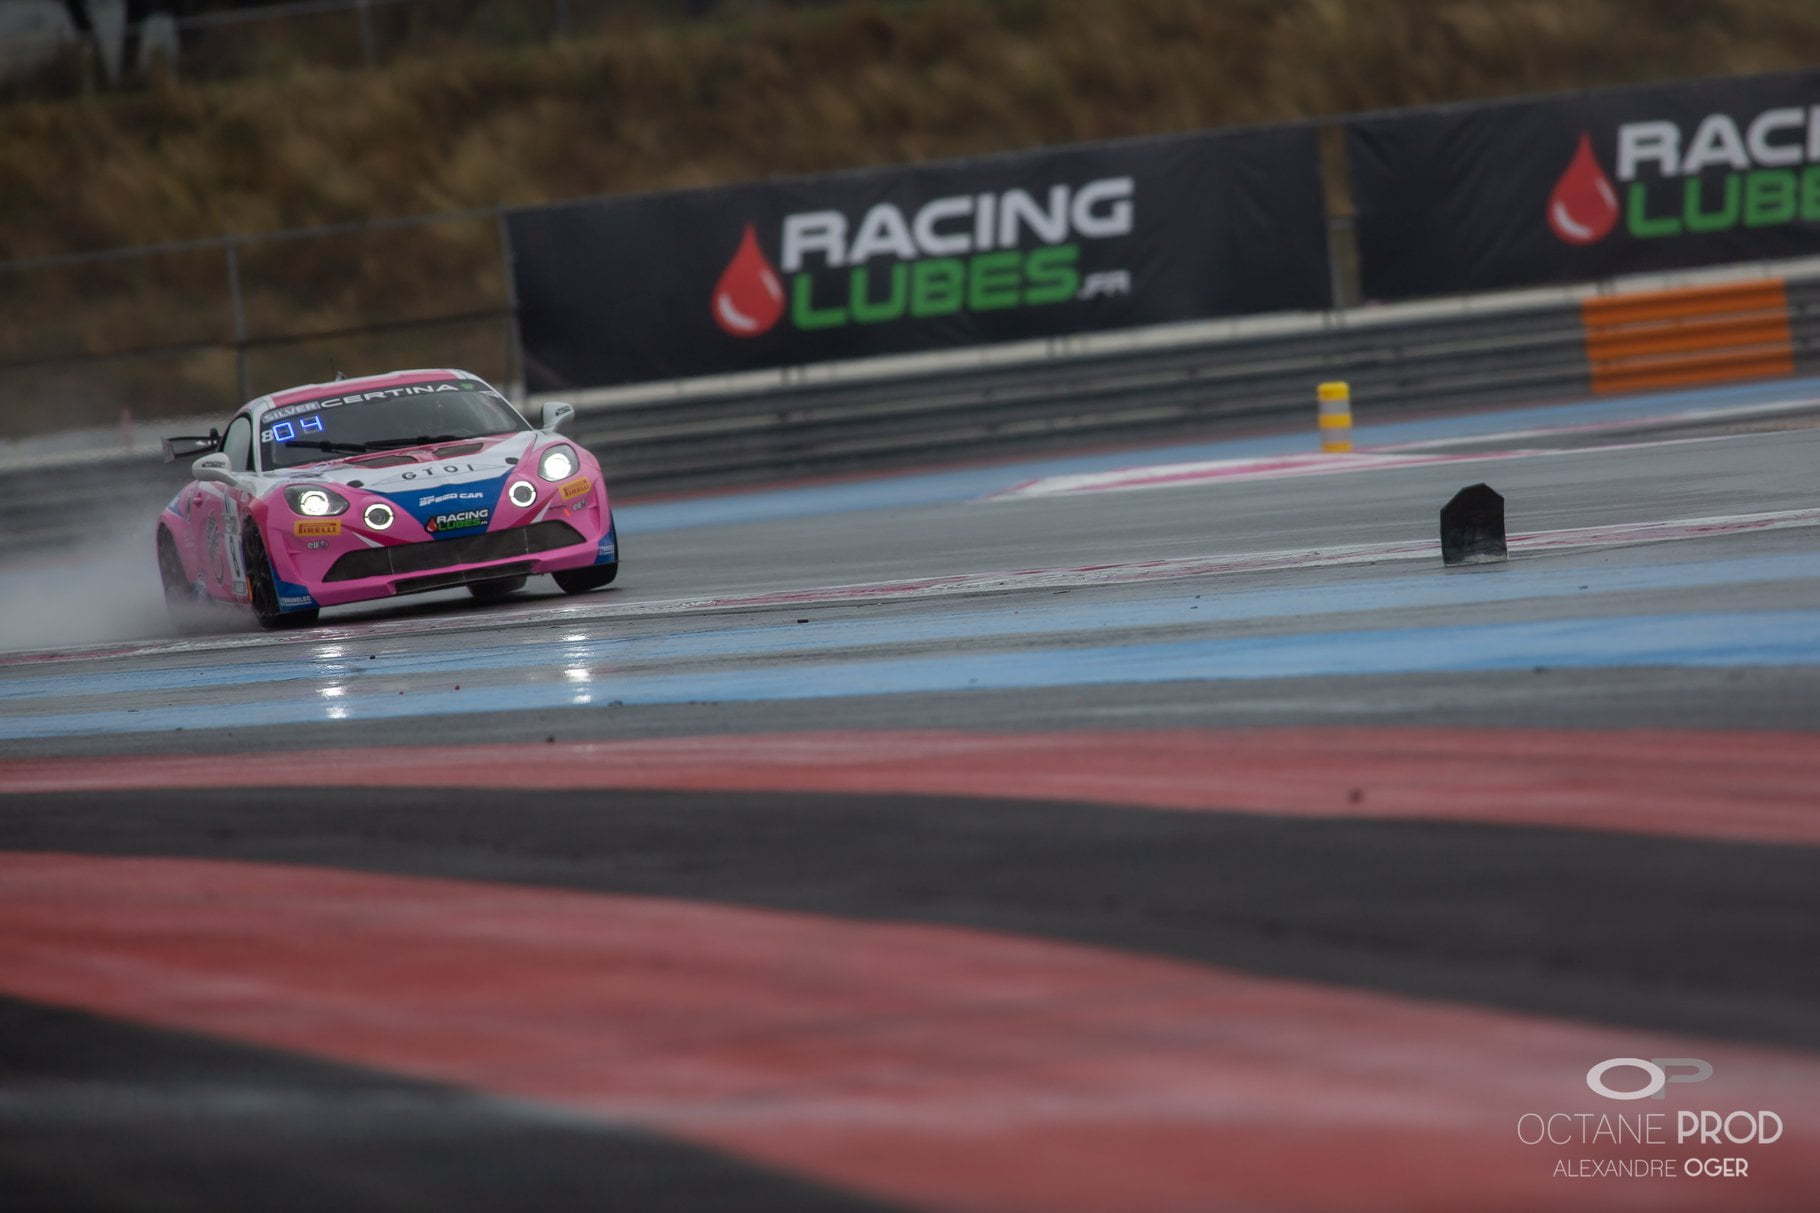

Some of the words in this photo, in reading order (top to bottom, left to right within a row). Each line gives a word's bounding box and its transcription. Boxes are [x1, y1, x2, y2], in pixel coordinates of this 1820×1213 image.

[781, 176, 1134, 273] RACING
[263, 401, 320, 424] SILVER
[321, 384, 459, 408] CERTINA
[299, 522, 337, 534] PIRELLI
[437, 509, 488, 523] RACING
